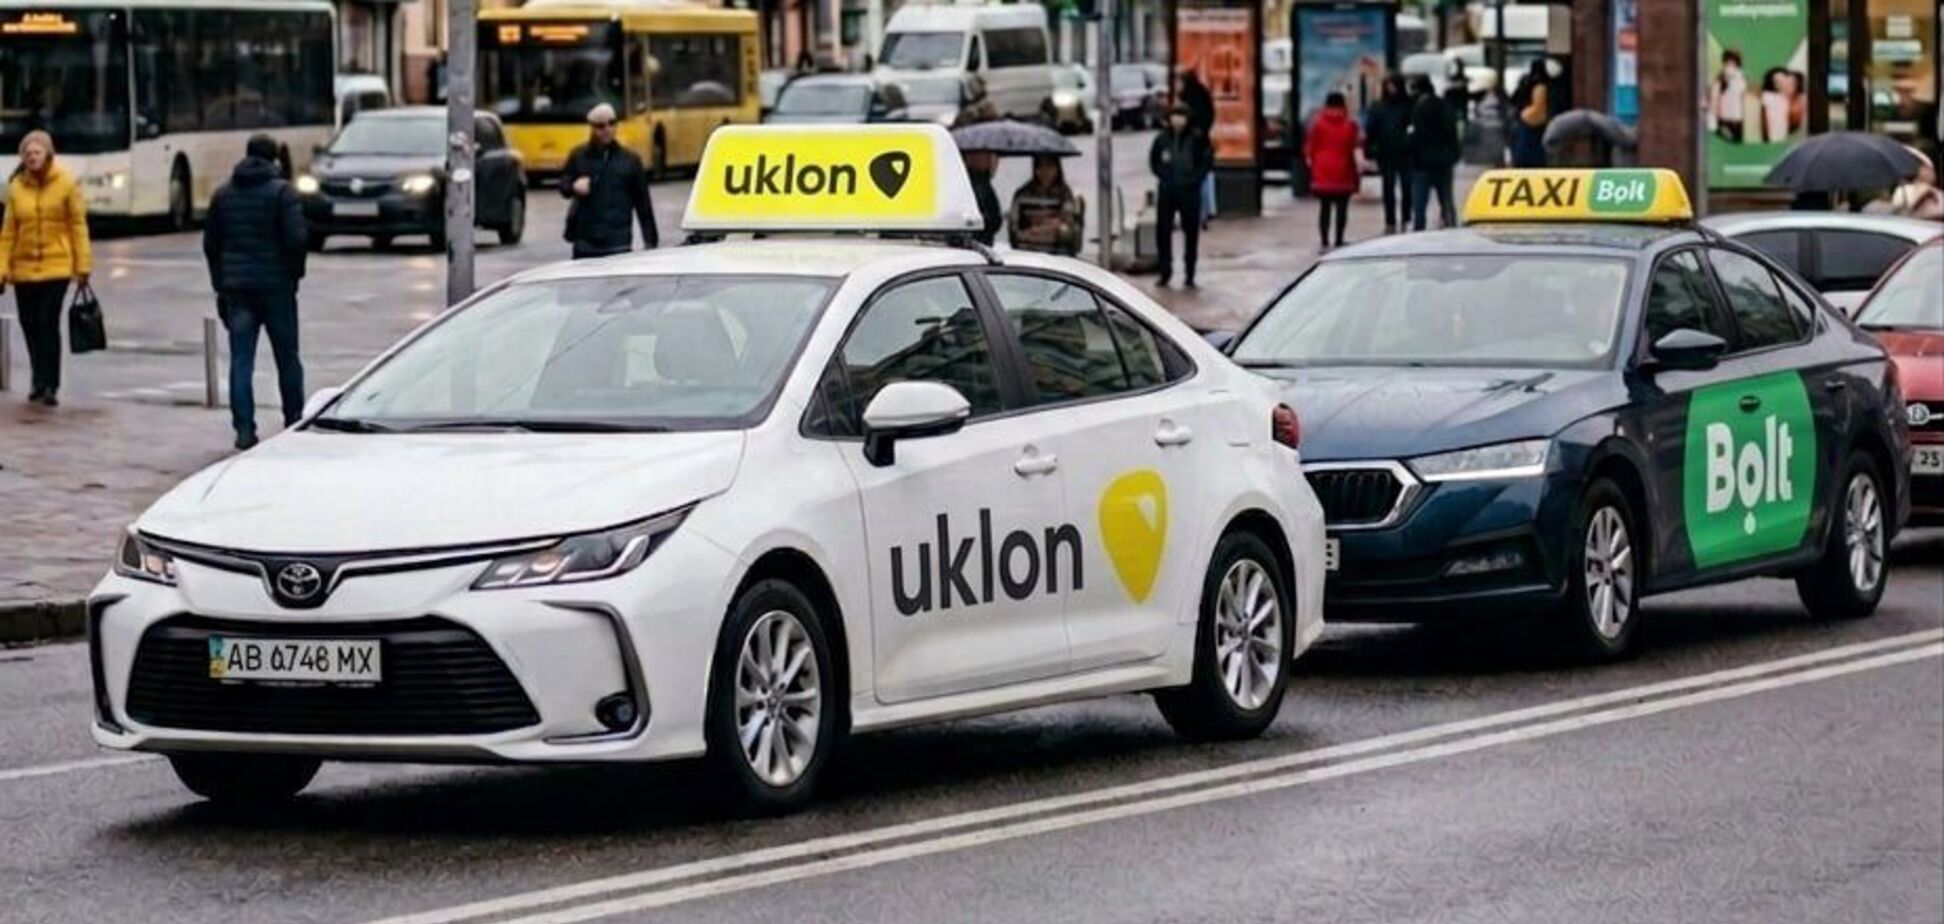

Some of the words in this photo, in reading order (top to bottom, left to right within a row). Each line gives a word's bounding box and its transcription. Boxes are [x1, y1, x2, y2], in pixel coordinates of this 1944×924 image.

[724, 154, 857, 195] uklon
[1487, 178, 1580, 207] TAXI
[1597, 179, 1646, 205] Bolt
[1706, 414, 1793, 535] Bolt
[890, 508, 1083, 616] uklon
[228, 643, 262, 671] AB
[337, 646, 373, 674] MX
